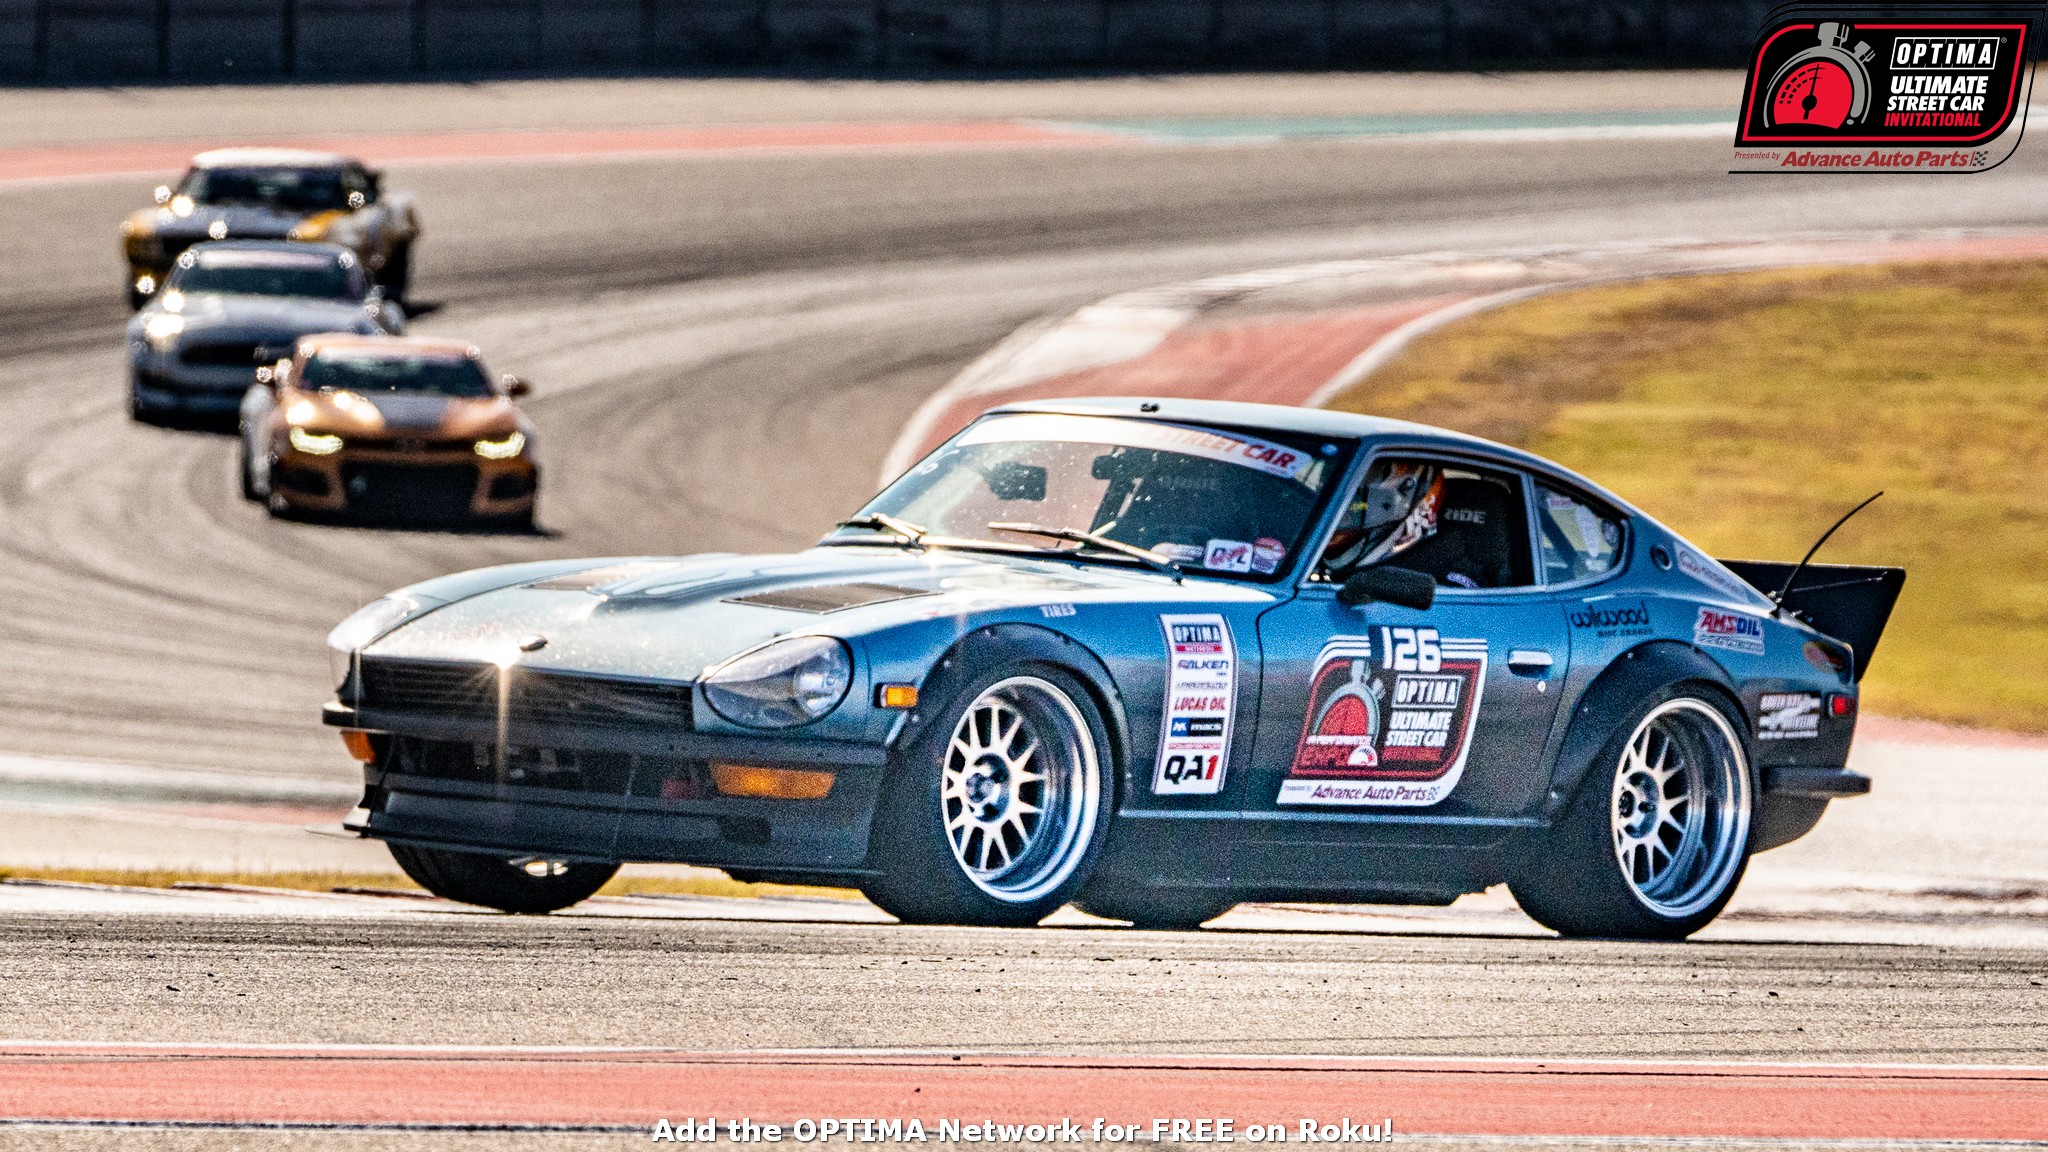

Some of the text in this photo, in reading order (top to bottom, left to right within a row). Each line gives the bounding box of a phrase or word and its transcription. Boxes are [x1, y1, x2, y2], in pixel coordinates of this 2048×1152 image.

[1243, 443, 1297, 469] CAR
[1174, 626, 1221, 642] OPTIMA
[1701, 611, 1761, 636] AMSOIL
[1381, 626, 1442, 672] 126
[1398, 679, 1457, 704] OPTIMA
[1174, 697, 1207, 711] LUCAS
[1389, 711, 1453, 730] ULTIMATE
[1384, 731, 1425, 747] STREET
[1423, 731, 1448, 747] CAR
[1164, 755, 1219, 784] QA1
[1311, 785, 1362, 799] Advance
[1363, 786, 1392, 800] Auto
[1393, 786, 1427, 801] Parts
